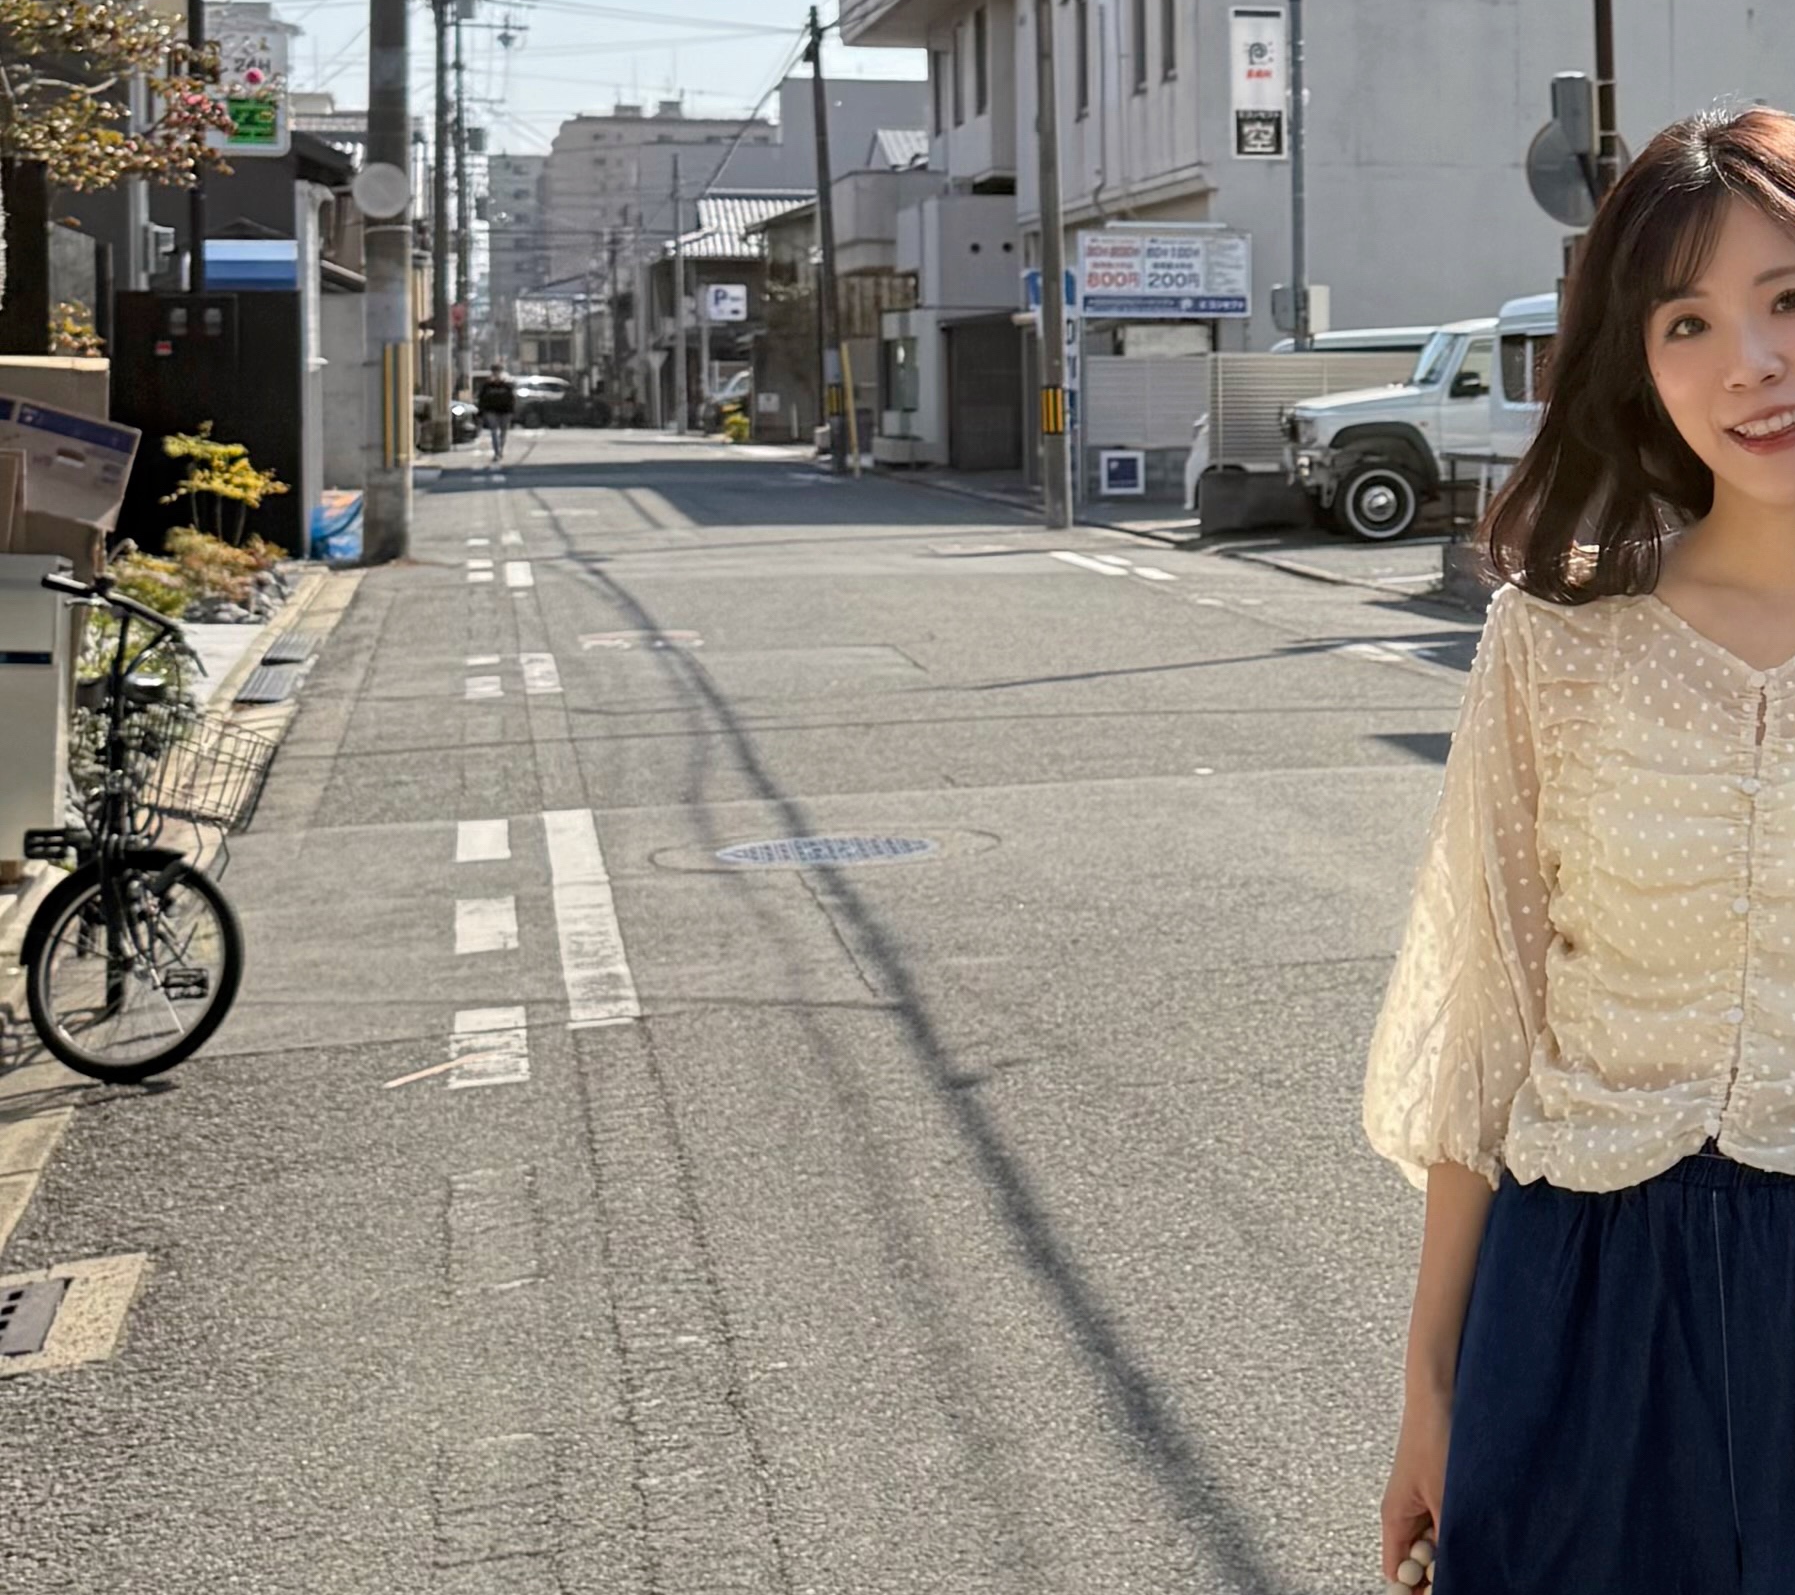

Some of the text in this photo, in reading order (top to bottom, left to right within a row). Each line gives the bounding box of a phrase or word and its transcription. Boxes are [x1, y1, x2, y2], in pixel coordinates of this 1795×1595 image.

[1243, 121, 1275, 152] 空
[1087, 272, 1140, 288] 800円
[1148, 272, 1200, 288] 200円
[714, 288, 728, 306] P
